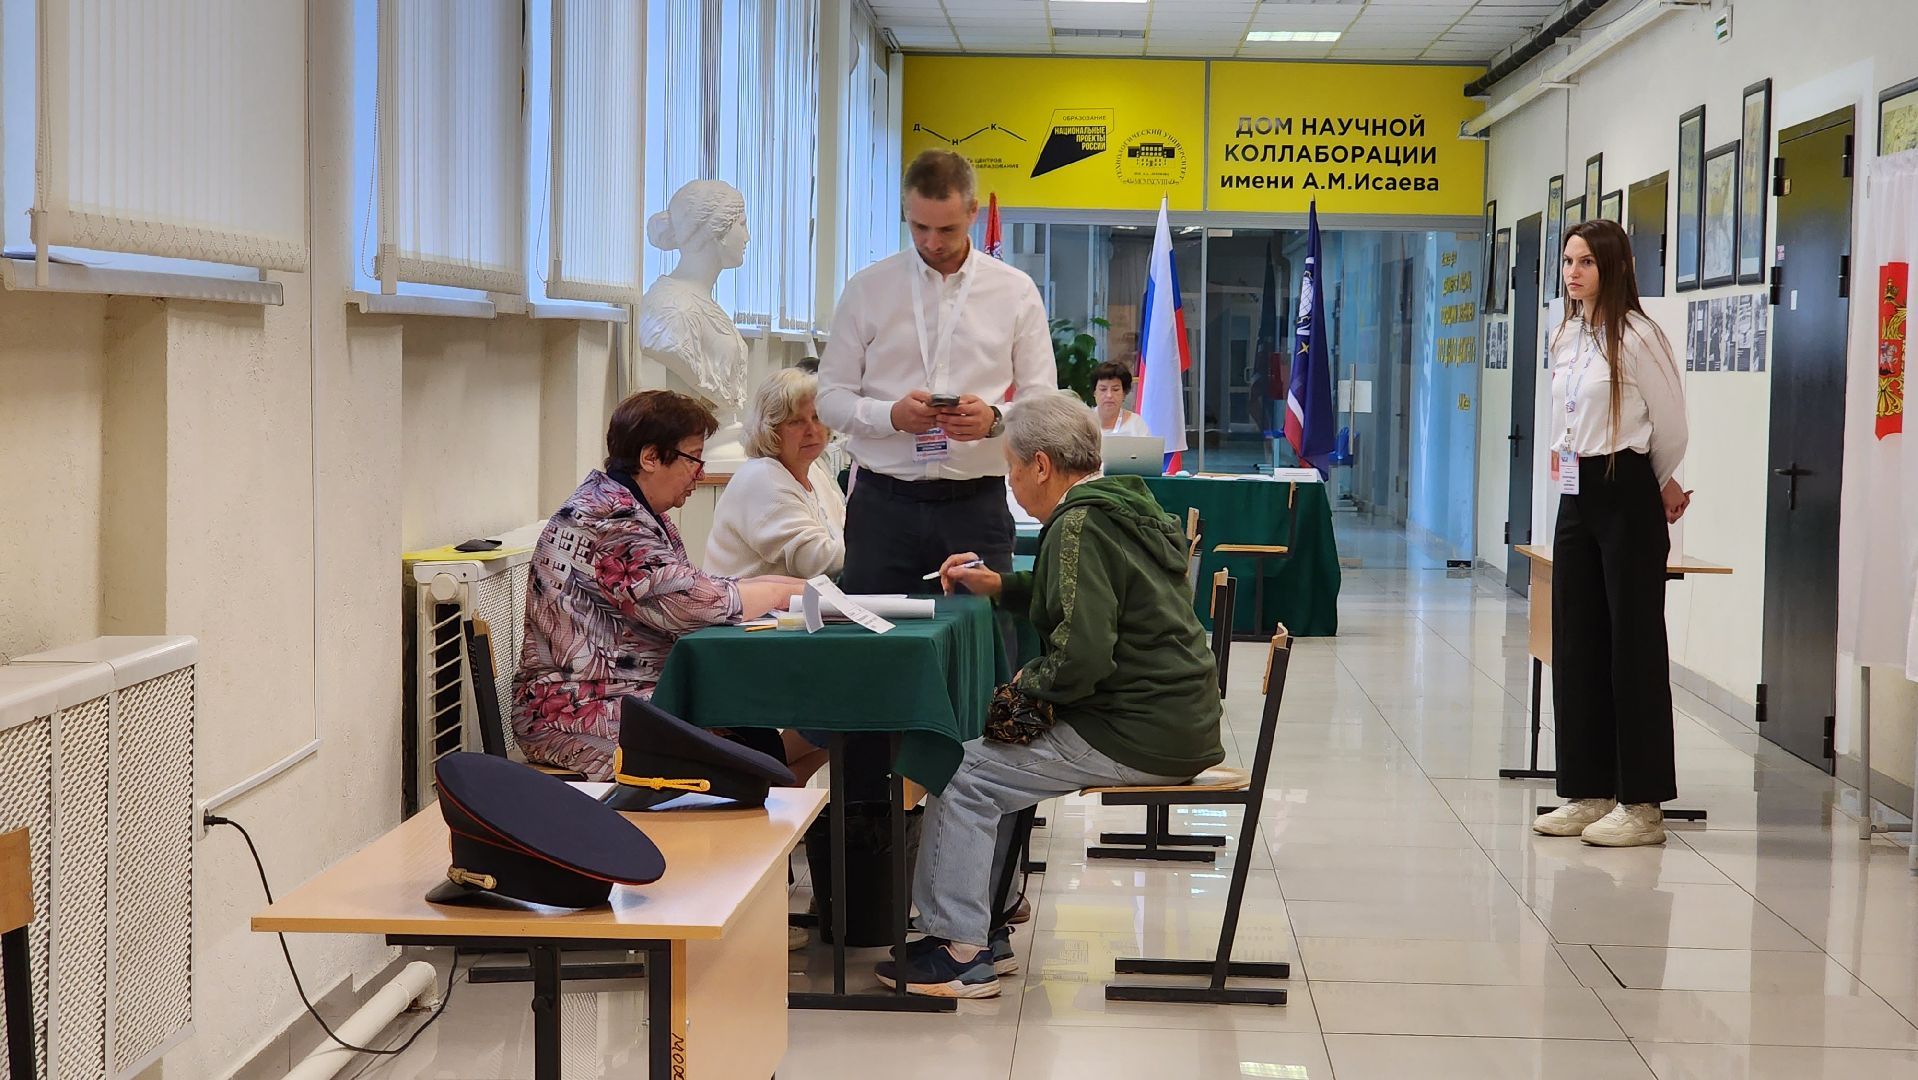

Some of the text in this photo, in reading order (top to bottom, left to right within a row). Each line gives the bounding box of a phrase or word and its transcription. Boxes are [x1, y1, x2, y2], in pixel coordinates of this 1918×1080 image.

[1054, 126, 1106, 135] НАЦИОНАЛЬНЫЕ
[1235, 114, 1425, 139] ДОМ НАУЧНОЙ
[1076, 135, 1106, 143] ПРОЕКТЫ
[1081, 142, 1106, 151] РОССИИ
[1224, 143, 1437, 167] КОЛЛАБОРАЦИИ
[1220, 172, 1439, 191] имени А.М.Исаева
